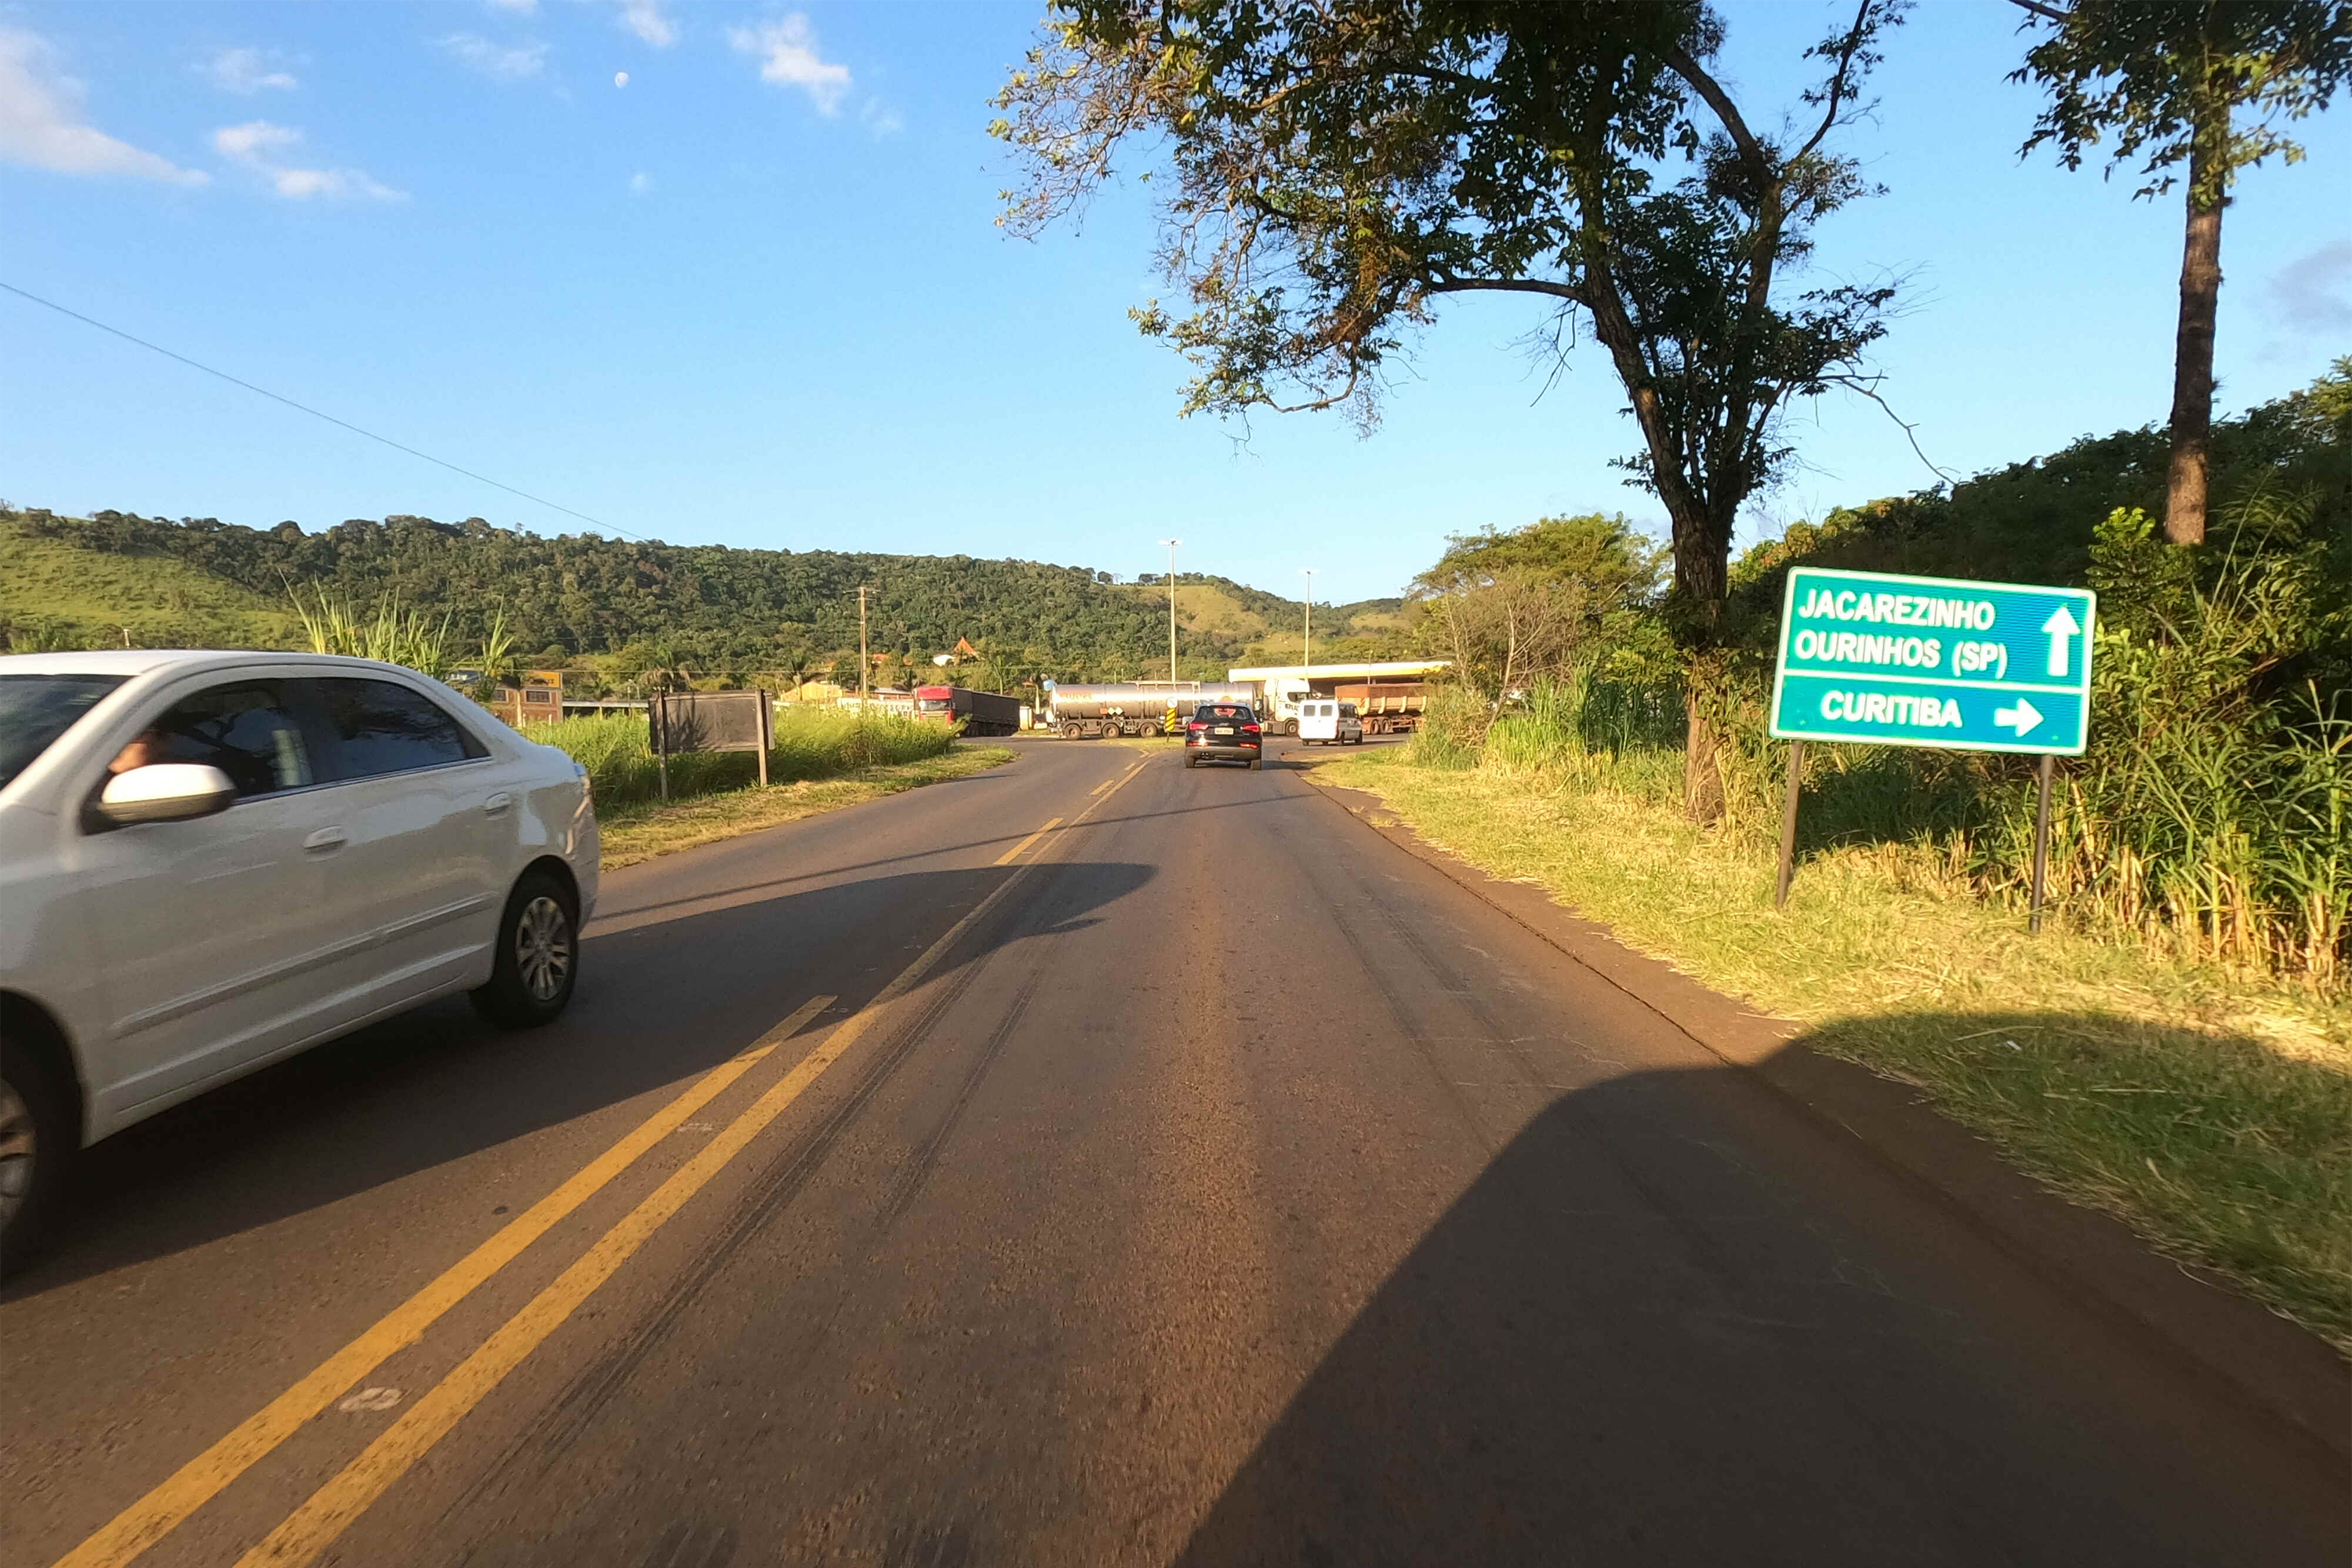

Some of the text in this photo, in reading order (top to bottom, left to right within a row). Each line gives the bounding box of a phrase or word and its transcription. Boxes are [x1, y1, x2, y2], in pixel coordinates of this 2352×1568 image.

[1798, 589, 1995, 630] JACAREZINHO
[1795, 630, 2008, 680] OURINHOS (SP)
[1820, 690, 1963, 728] CURITIBA
